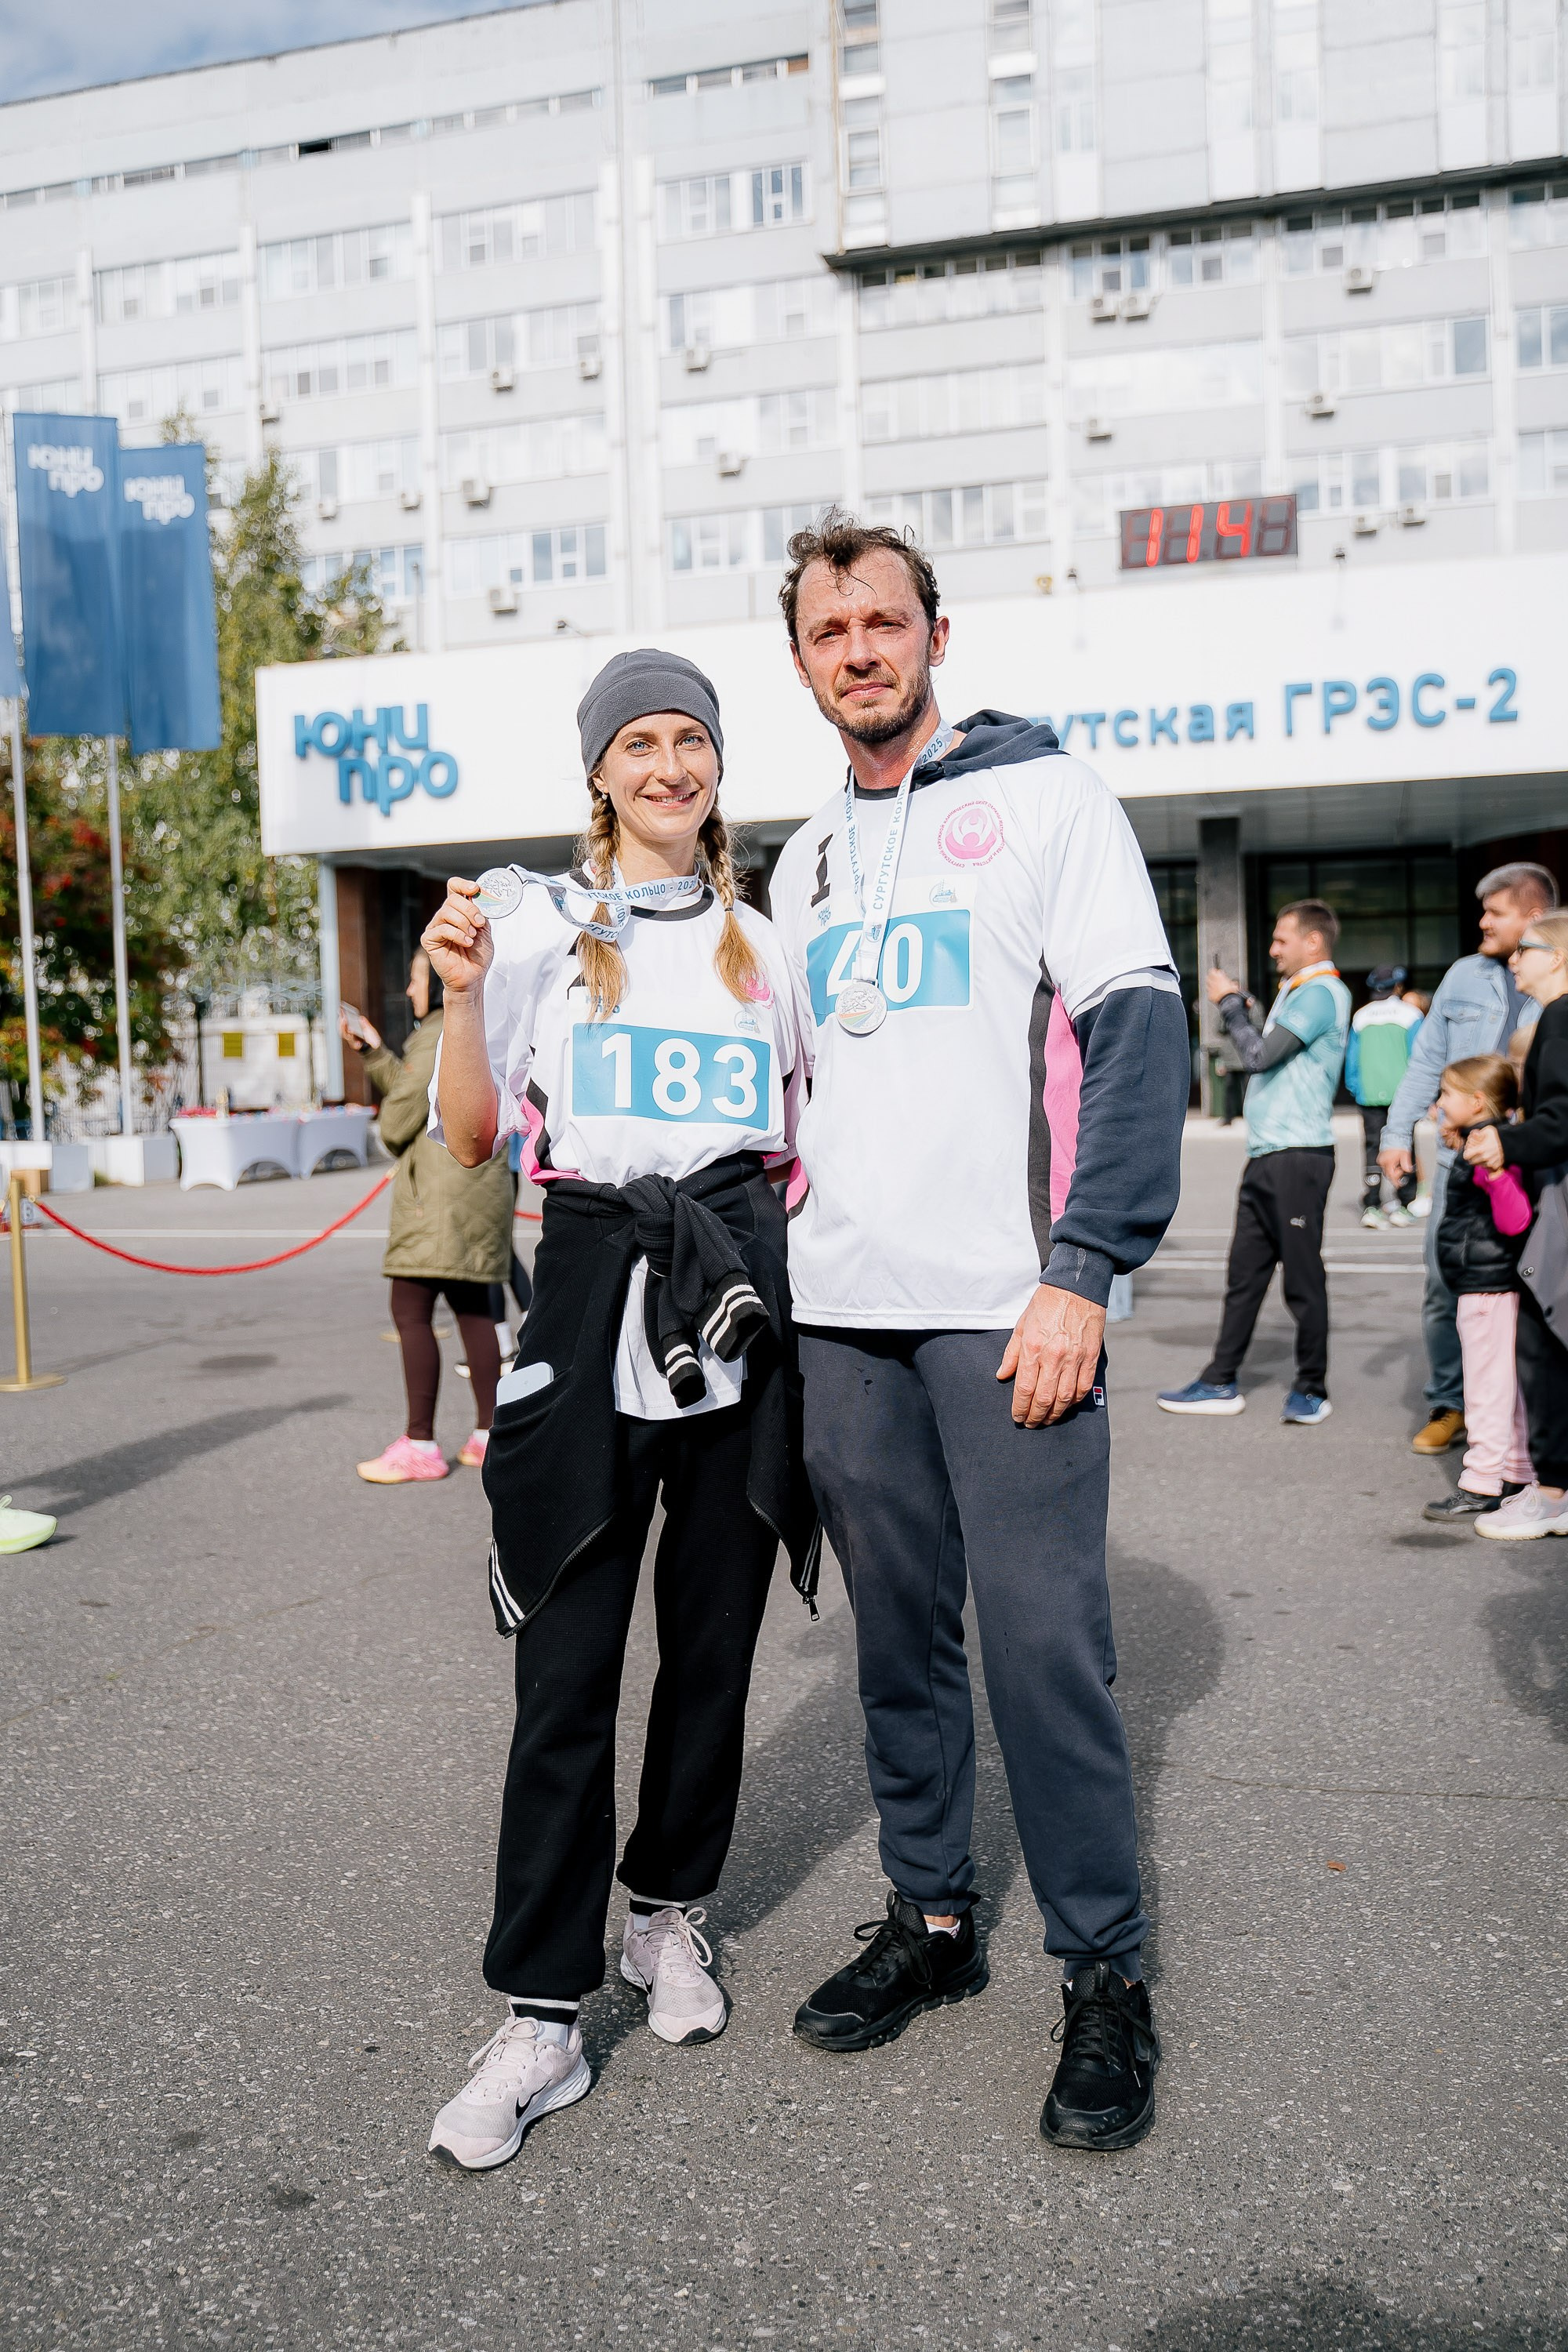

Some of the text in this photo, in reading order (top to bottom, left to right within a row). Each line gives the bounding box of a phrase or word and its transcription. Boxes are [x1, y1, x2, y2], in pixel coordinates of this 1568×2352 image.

[1284, 668, 1519, 737] ГРЭС-2
[921, 738, 944, 764] 2025
[624, 884, 666, 900] КОЛЬЦО
[873, 829, 898, 909] СУРГУТСКОЕ
[826, 923, 923, 1004] 40
[601, 1033, 757, 1119] 183
